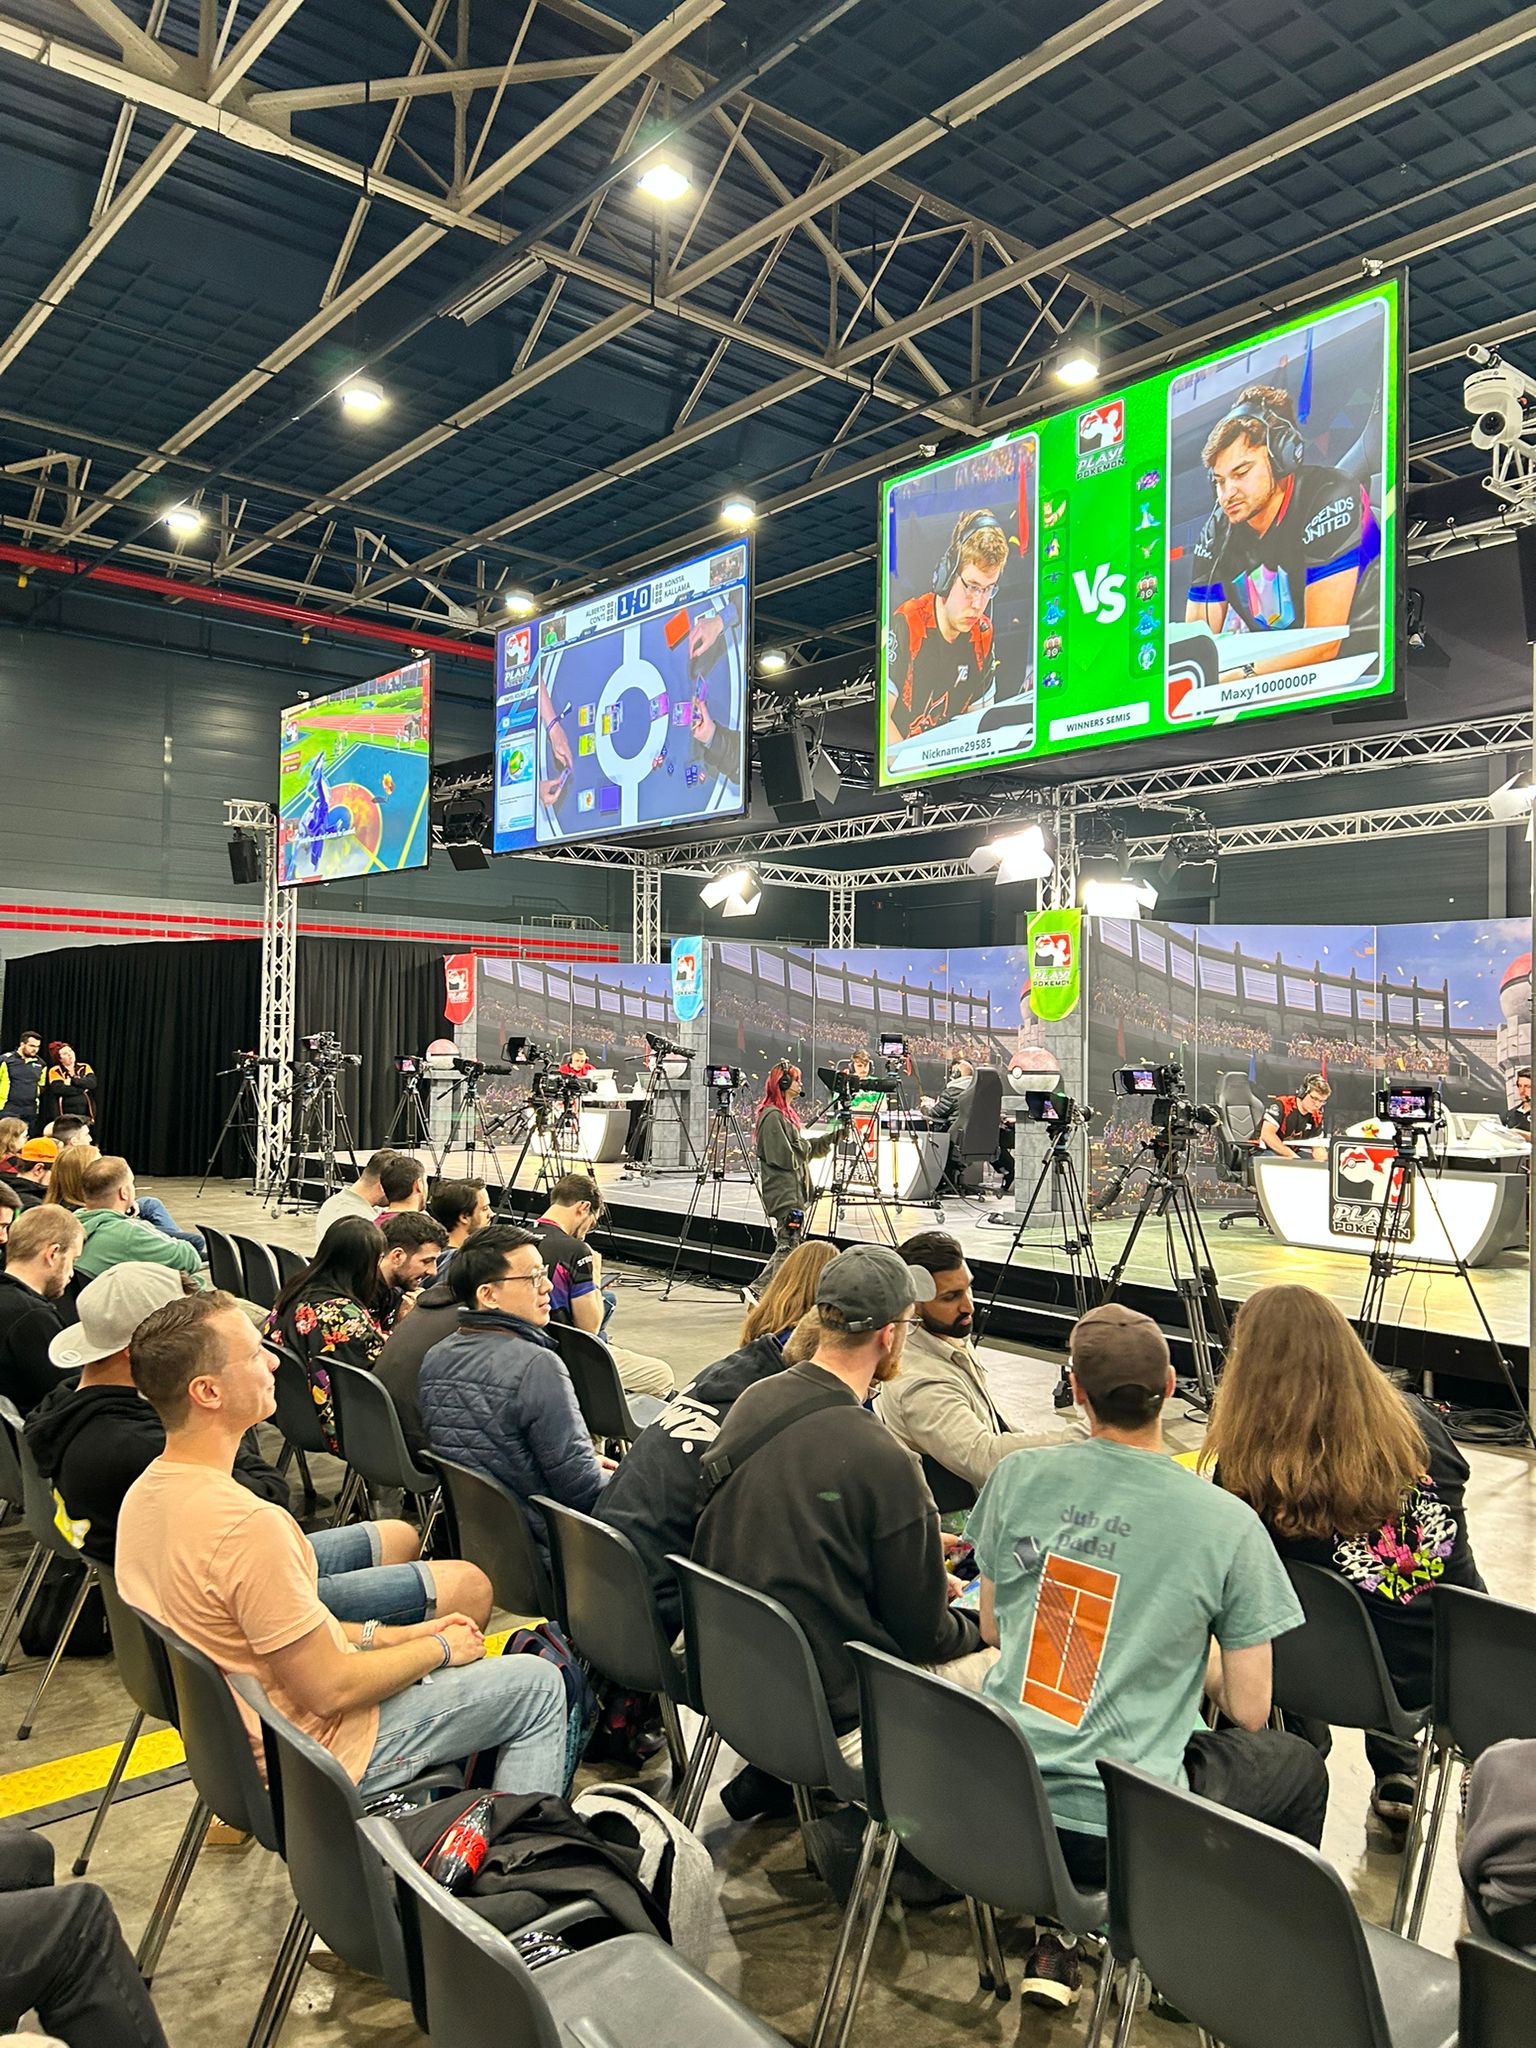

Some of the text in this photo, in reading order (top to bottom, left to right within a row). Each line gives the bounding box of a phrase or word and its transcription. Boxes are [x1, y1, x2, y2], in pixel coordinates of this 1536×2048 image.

[1078, 445, 1125, 472] PLAY!
[1302, 512, 1351, 544] UNITED
[664, 575, 685, 587] KONSTA
[1072, 563, 1127, 624] VS
[586, 604, 606, 617] ALBERTO
[620, 588, 649, 616] 1 0
[1221, 672, 1317, 702] Maxy1000000P
[1066, 712, 1131, 733] WINNERS SEMIS
[922, 736, 992, 760] Nickname29585
[1061, 1504, 1132, 1537] club de
[1055, 1533, 1117, 1560] padel
[1377, 1556, 1445, 1600] VANS
